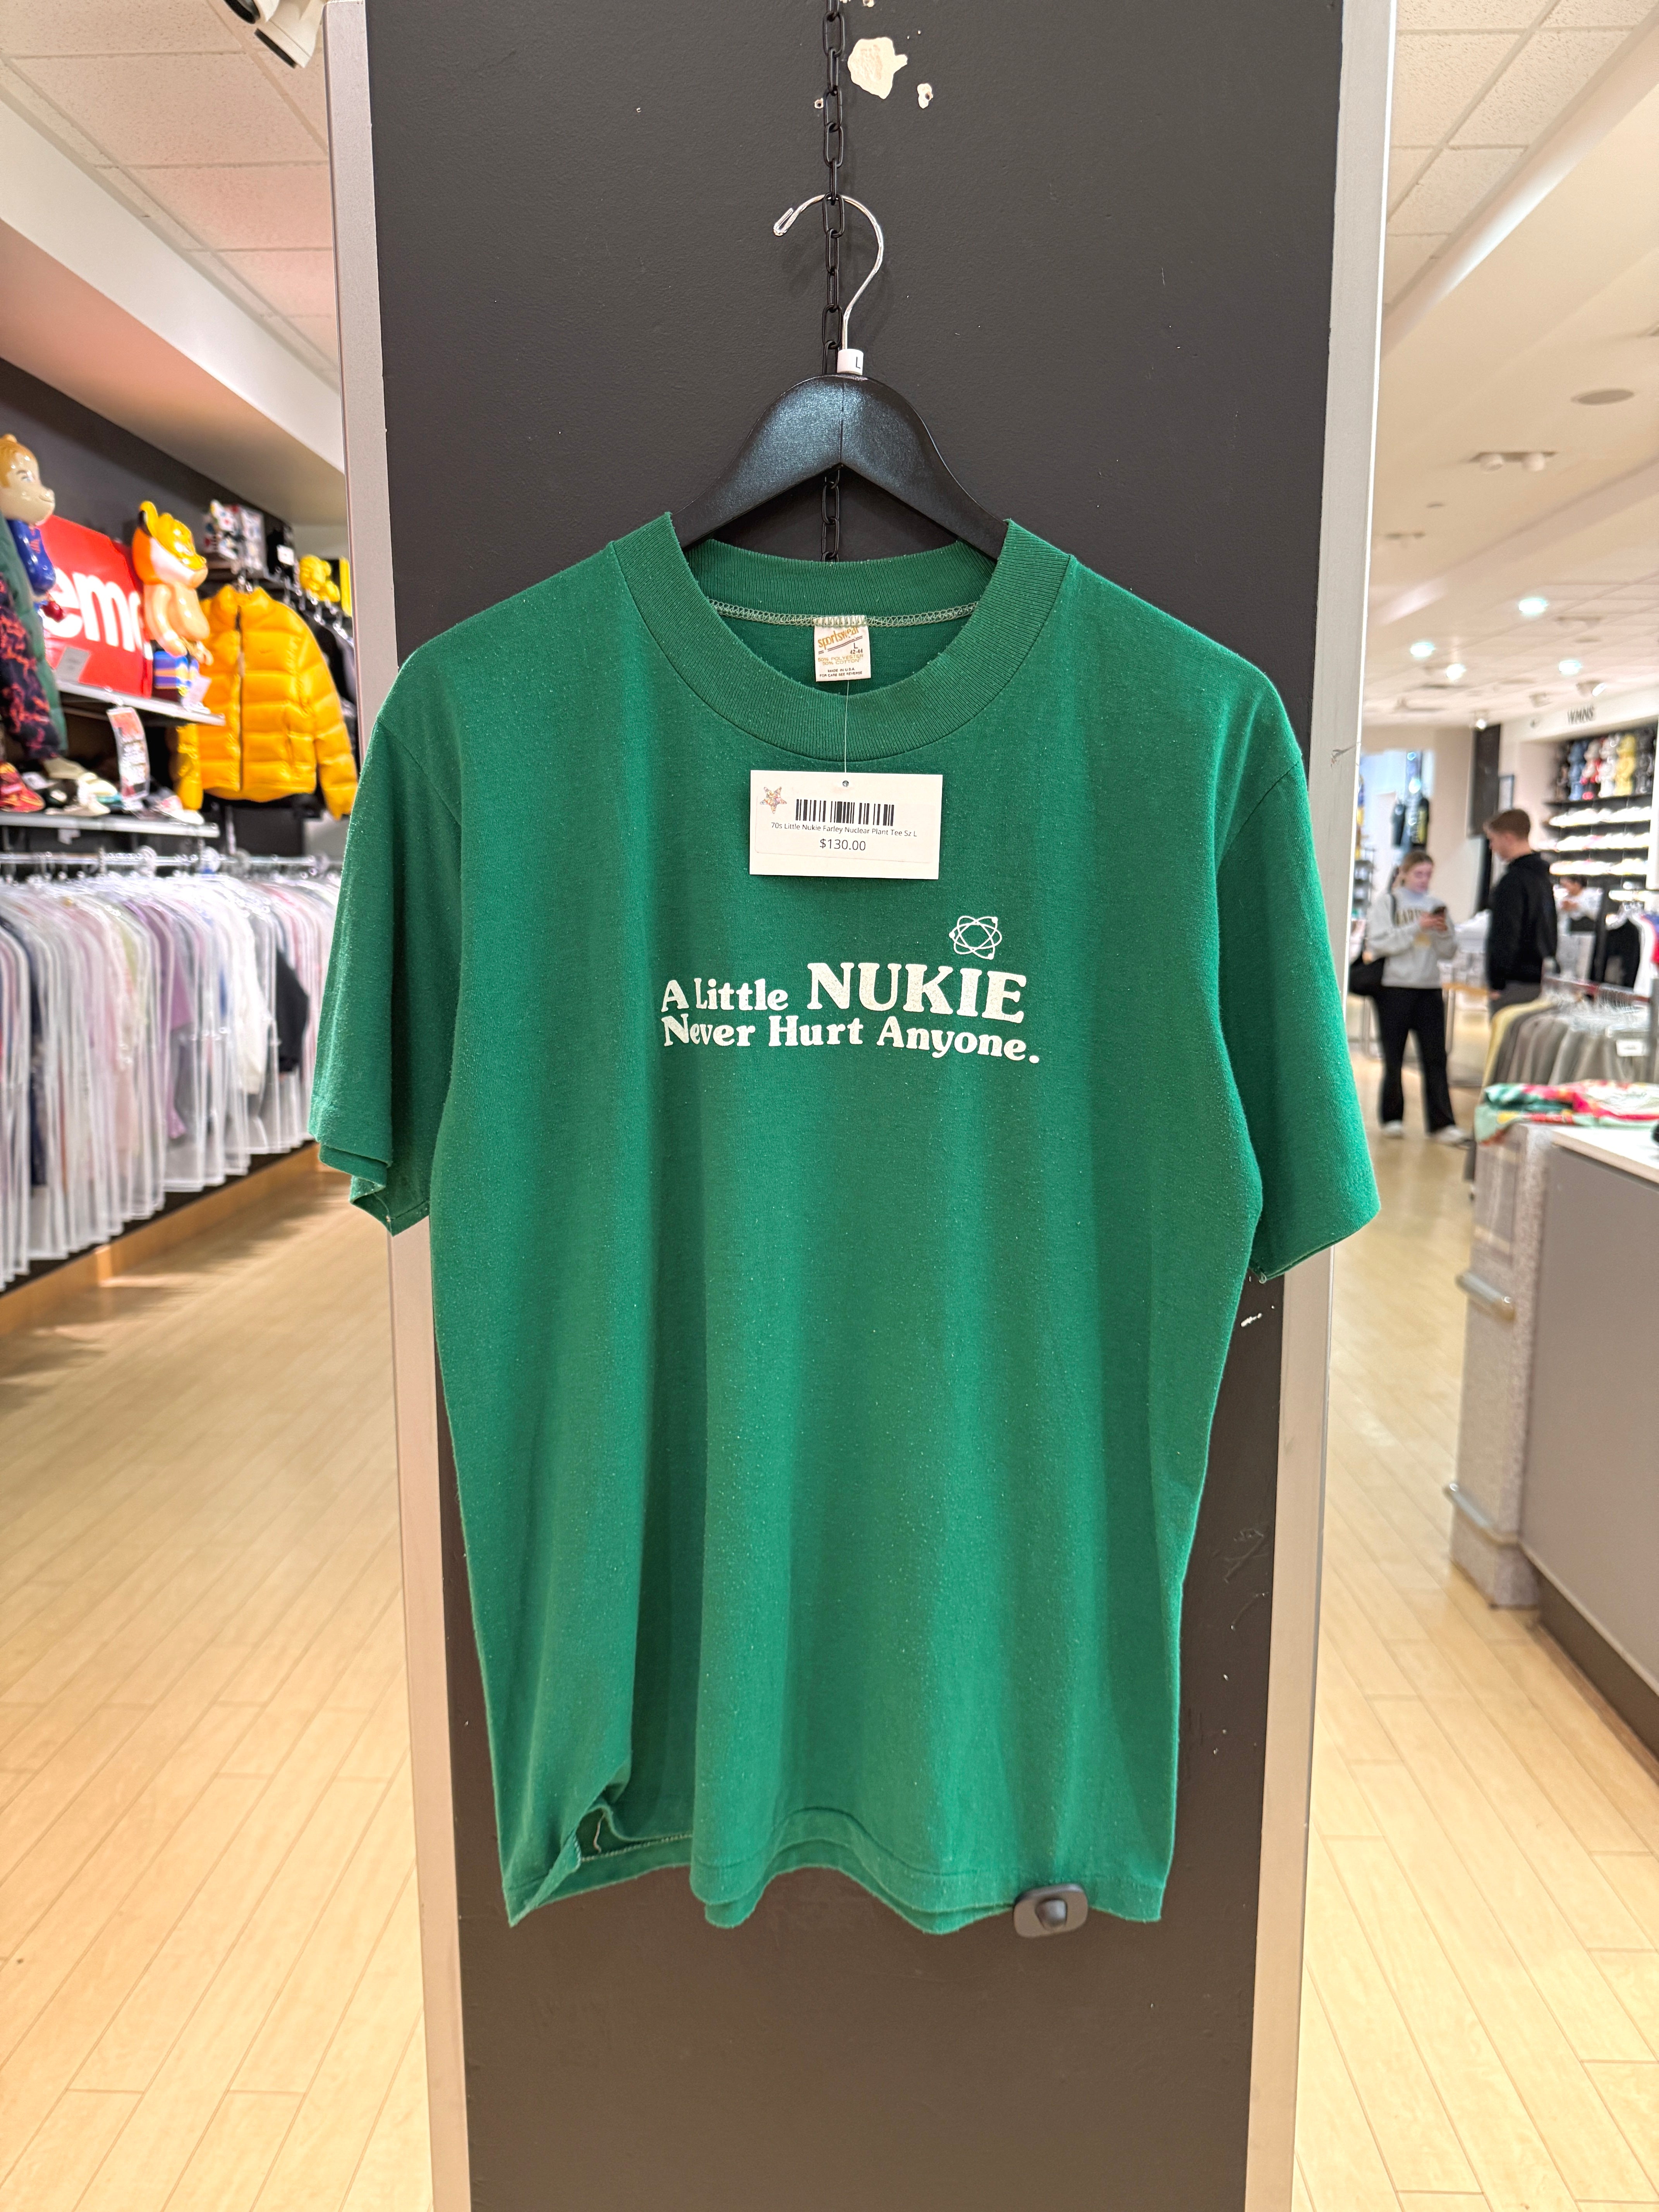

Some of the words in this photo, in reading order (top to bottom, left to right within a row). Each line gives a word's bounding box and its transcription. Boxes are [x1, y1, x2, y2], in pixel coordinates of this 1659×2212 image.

[855, 356, 861, 369] L
[823, 825, 843, 834] Farley
[820, 838, 866, 851] $130.00
[661, 980, 689, 1012] A
[694, 978, 788, 1010] Little
[807, 962, 1027, 1024] NUKIE
[661, 1013, 756, 1046] Never
[768, 1015, 864, 1047] Hurt
[876, 1016, 1039, 1063] Anyone.
